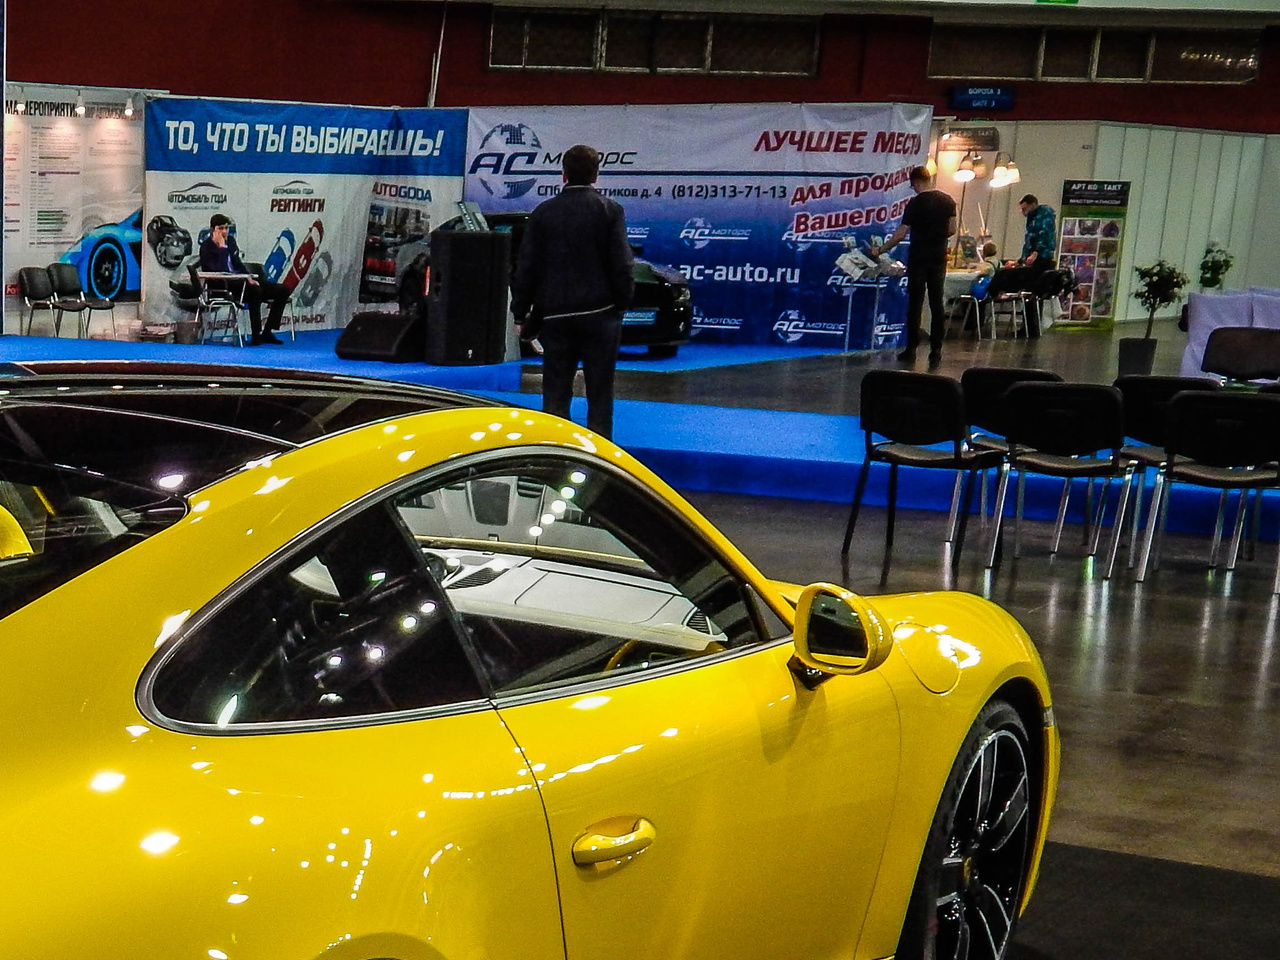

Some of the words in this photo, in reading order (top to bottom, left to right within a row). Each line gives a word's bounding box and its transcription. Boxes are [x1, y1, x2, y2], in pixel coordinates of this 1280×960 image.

[21, 100, 82, 118] МЕРОПРИЯТИ
[165, 120, 199, 154] ТО,
[207, 121, 250, 152] ЧТО
[255, 123, 287, 153] ТЫ
[290, 125, 445, 157] ВЫБИРАЕШЬ!
[753, 130, 868, 153] ЛУЧШЕЕ
[872, 131, 922, 155] МЕСТО
[210, 193, 228, 205] ГОДА
[371, 181, 433, 203] AUTOGODA
[640, 185, 652, 199] д.
[654, 185, 663, 197] 4
[671, 183, 787, 200] (812)313-71-13
[790, 181, 832, 206] для
[793, 204, 888, 234] Вашего
